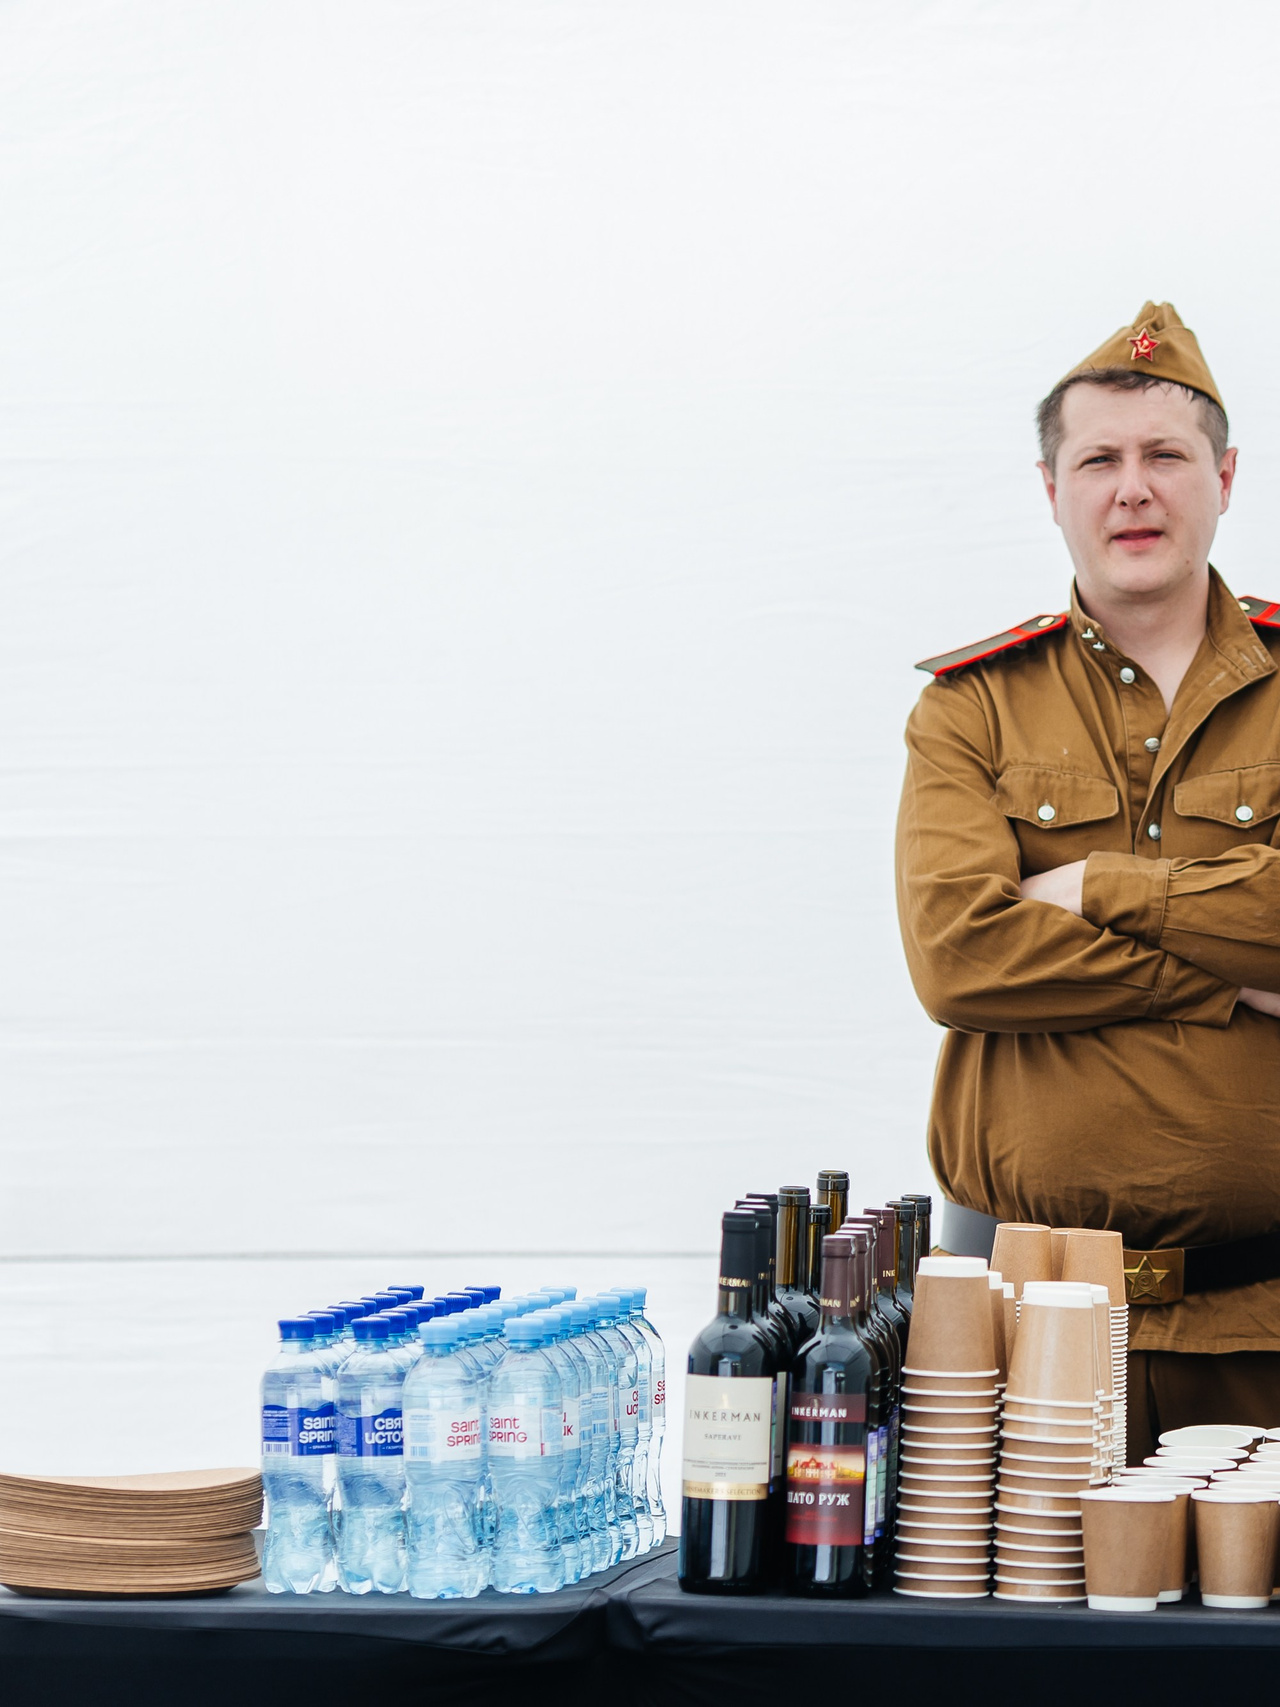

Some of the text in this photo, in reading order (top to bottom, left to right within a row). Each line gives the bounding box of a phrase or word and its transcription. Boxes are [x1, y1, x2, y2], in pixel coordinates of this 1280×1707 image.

[689, 1409, 761, 1422] INKERMAN
[791, 1406, 847, 1418] INKERMAN
[298, 1429, 335, 1444] SPRIN
[818, 1492, 850, 1507] РУЖ
